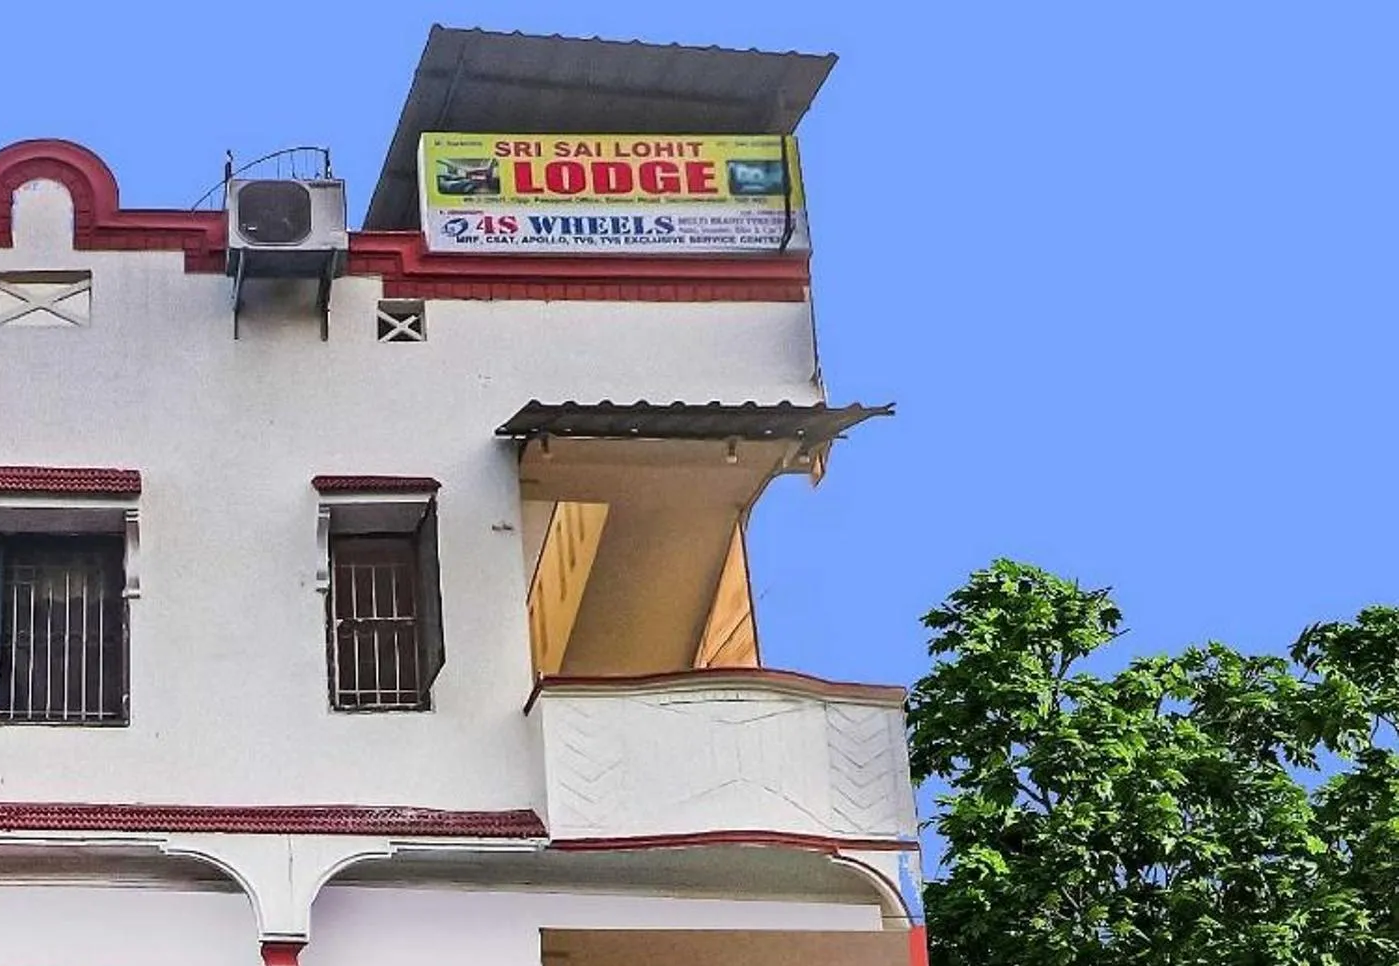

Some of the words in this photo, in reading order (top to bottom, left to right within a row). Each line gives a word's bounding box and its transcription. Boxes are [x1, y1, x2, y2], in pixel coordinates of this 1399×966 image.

[495, 141, 542, 158] SRI
[554, 141, 602, 158] SAI
[614, 141, 703, 158] LOHIT
[514, 160, 719, 195] LODGE
[476, 215, 519, 235] 4S
[527, 215, 676, 235] WHEELS
